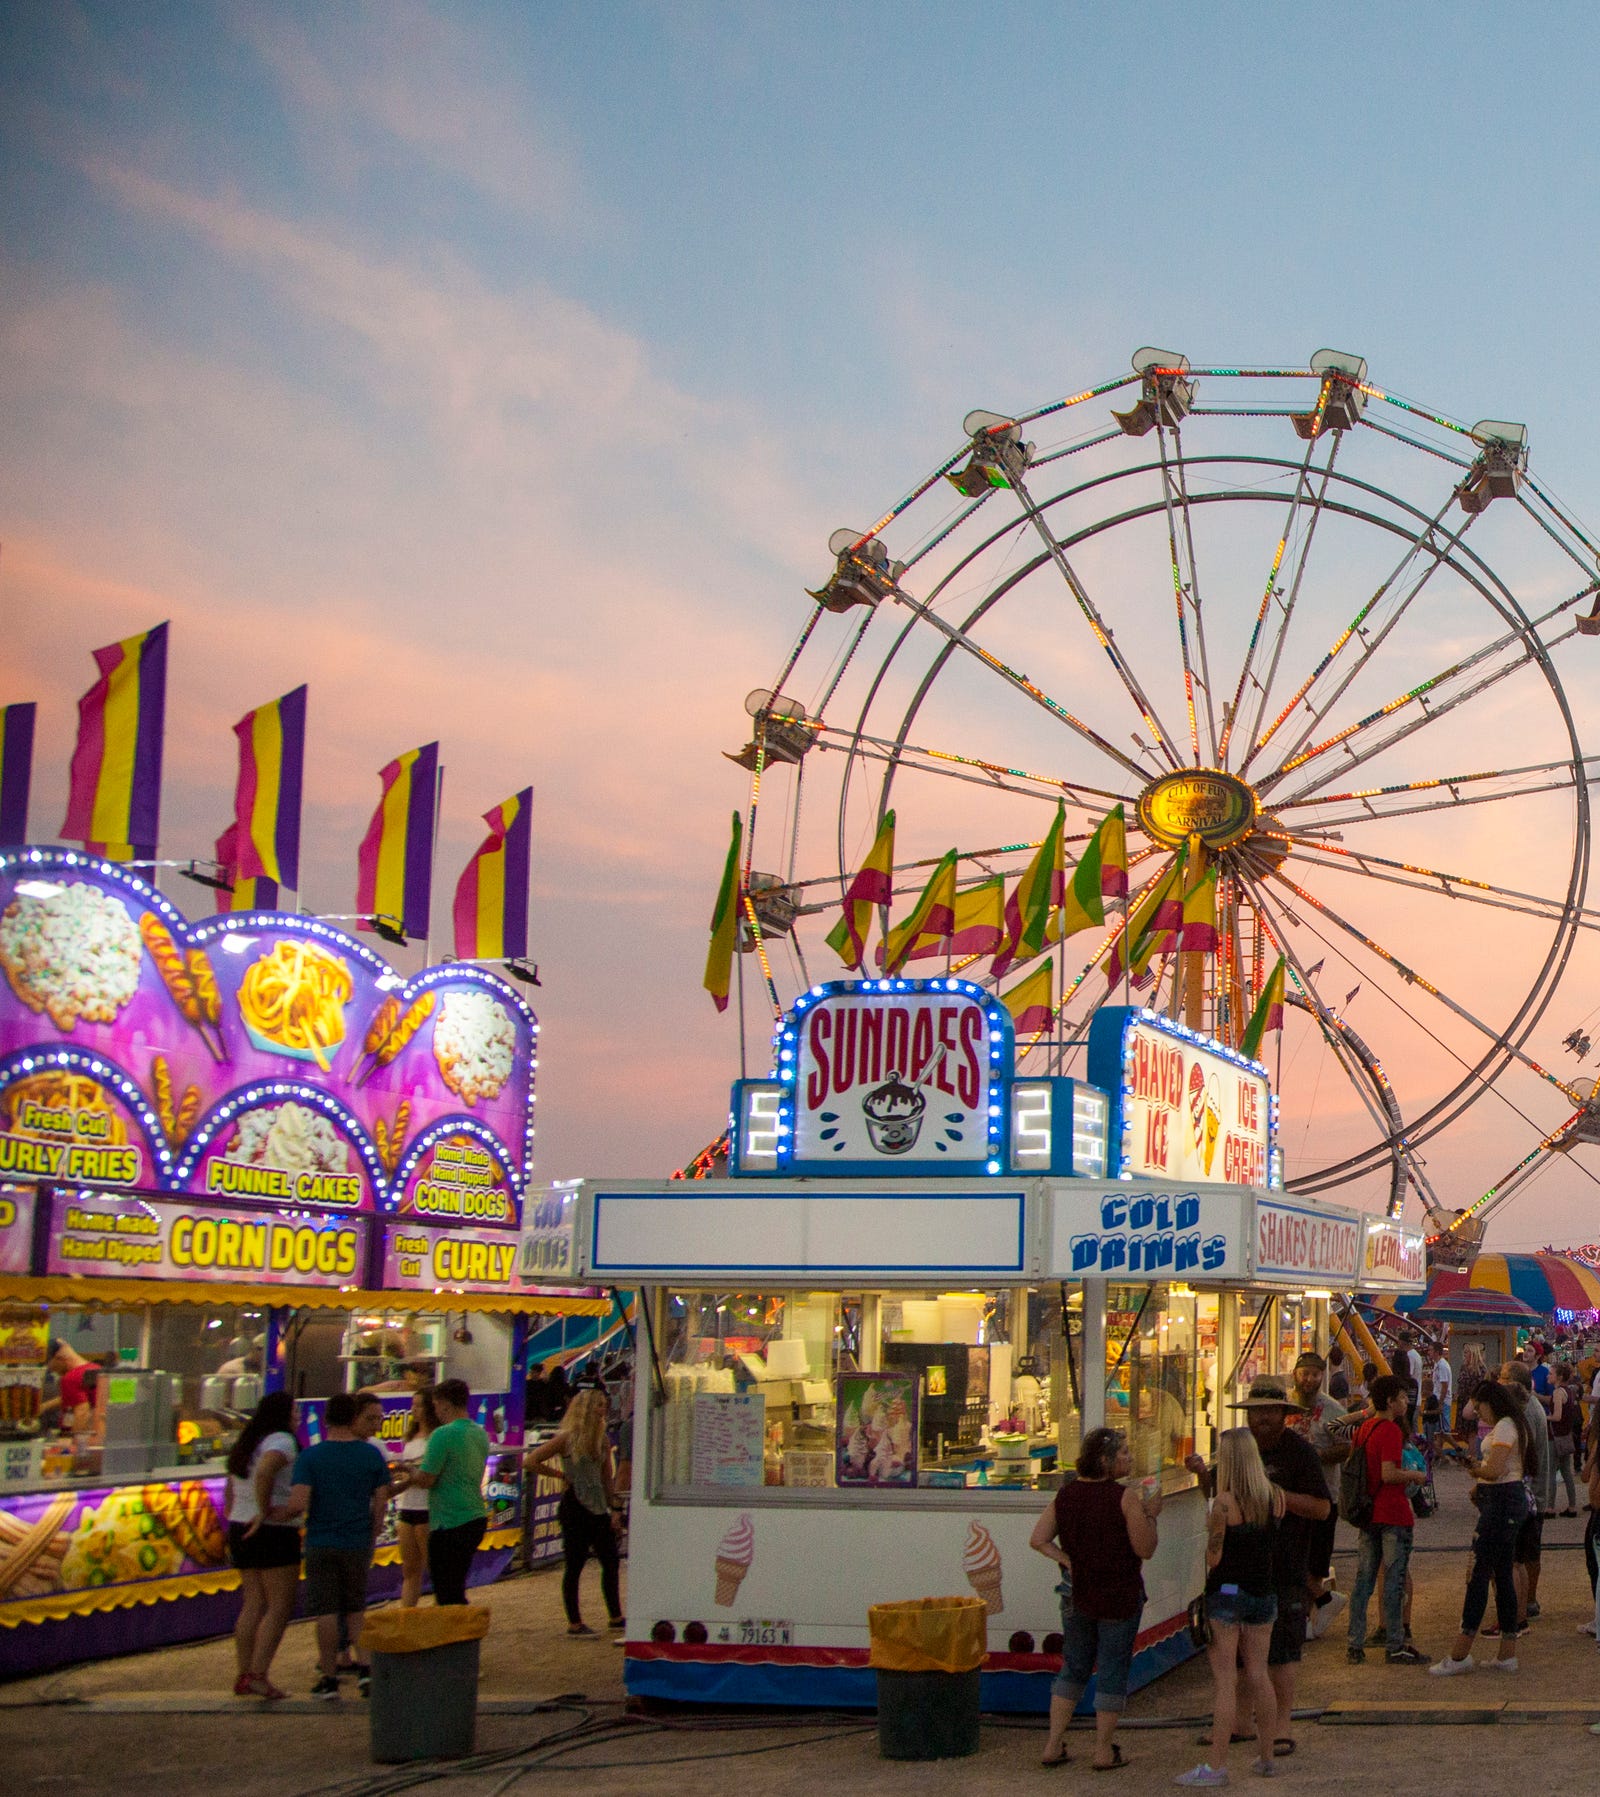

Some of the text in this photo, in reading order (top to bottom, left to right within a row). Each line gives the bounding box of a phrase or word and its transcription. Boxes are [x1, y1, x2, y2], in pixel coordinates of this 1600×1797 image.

[1168, 782, 1227, 799] CITY OF FUN
[1167, 811, 1223, 828] CARNIVAL
[806, 1006, 982, 1111] SUNDAES
[1131, 1031, 1184, 1112] SHAVED
[23, 1103, 108, 1137] Fresh Cut
[1237, 1076, 1257, 1135] ICE
[436, 1145, 490, 1167] Home Made
[1144, 1105, 1169, 1172] ICE
[1224, 1130, 1265, 1186] CREAM
[0, 1138, 138, 1184] URLY FRIES
[433, 1165, 491, 1187] Hand Dipped
[210, 1160, 360, 1205] FUNNEL CAKES
[416, 1184, 506, 1218] CORN DOGS
[66, 1208, 114, 1233] Home
[1101, 1192, 1200, 1231] COLD
[63, 1237, 162, 1266] Hand Dipped
[171, 1215, 357, 1274] CORN DOGS
[395, 1234, 428, 1254] Fresh
[433, 1240, 517, 1282] CURLY
[1070, 1231, 1226, 1272] DRINKS
[1259, 1212, 1357, 1274] SHAKES & FLOATS
[1373, 1233, 1423, 1281] LEMONADE
[401, 1259, 420, 1276] Cut
[376, 1411, 404, 1440] old
[741, 1628, 775, 1643] 79163
